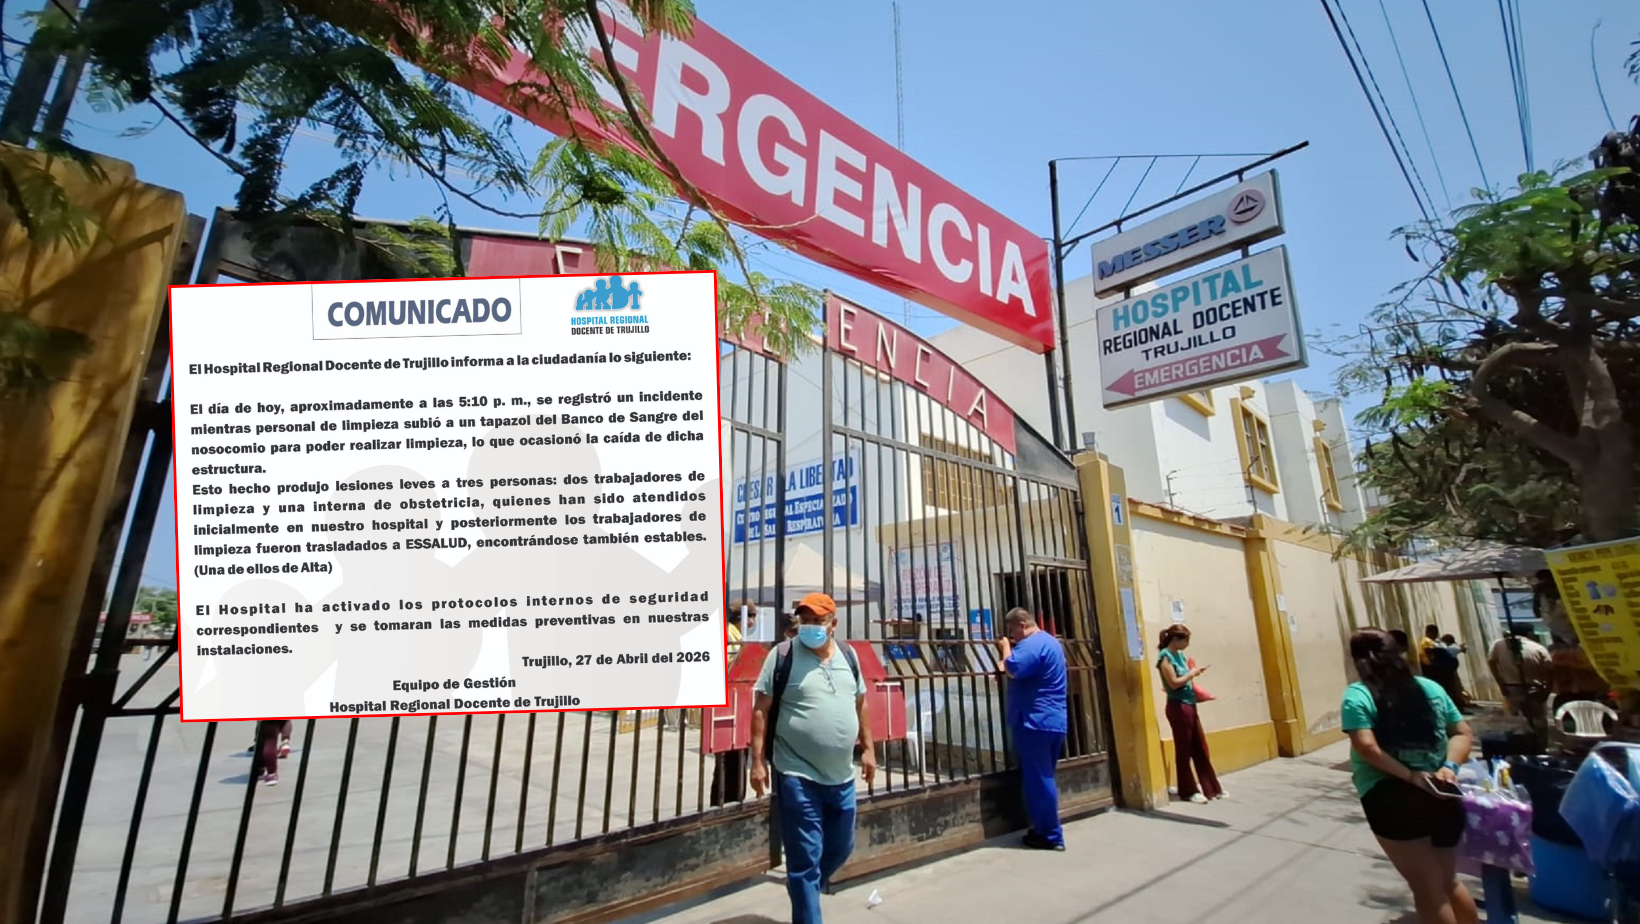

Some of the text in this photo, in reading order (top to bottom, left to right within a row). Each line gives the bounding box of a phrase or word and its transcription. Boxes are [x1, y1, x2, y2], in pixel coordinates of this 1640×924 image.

[540, 0, 1037, 318] ERGENCIA
[1098, 215, 1227, 280] MESSER
[1103, 287, 1283, 355] REGIONAL DOCENTE
[1112, 264, 1264, 331] HOSPITAL
[1134, 345, 1264, 390] EMERGENCIA
[1141, 325, 1237, 361] TRUJILLO
[800, 457, 853, 489] LIBETAD
[1114, 504, 1122, 524] 1
